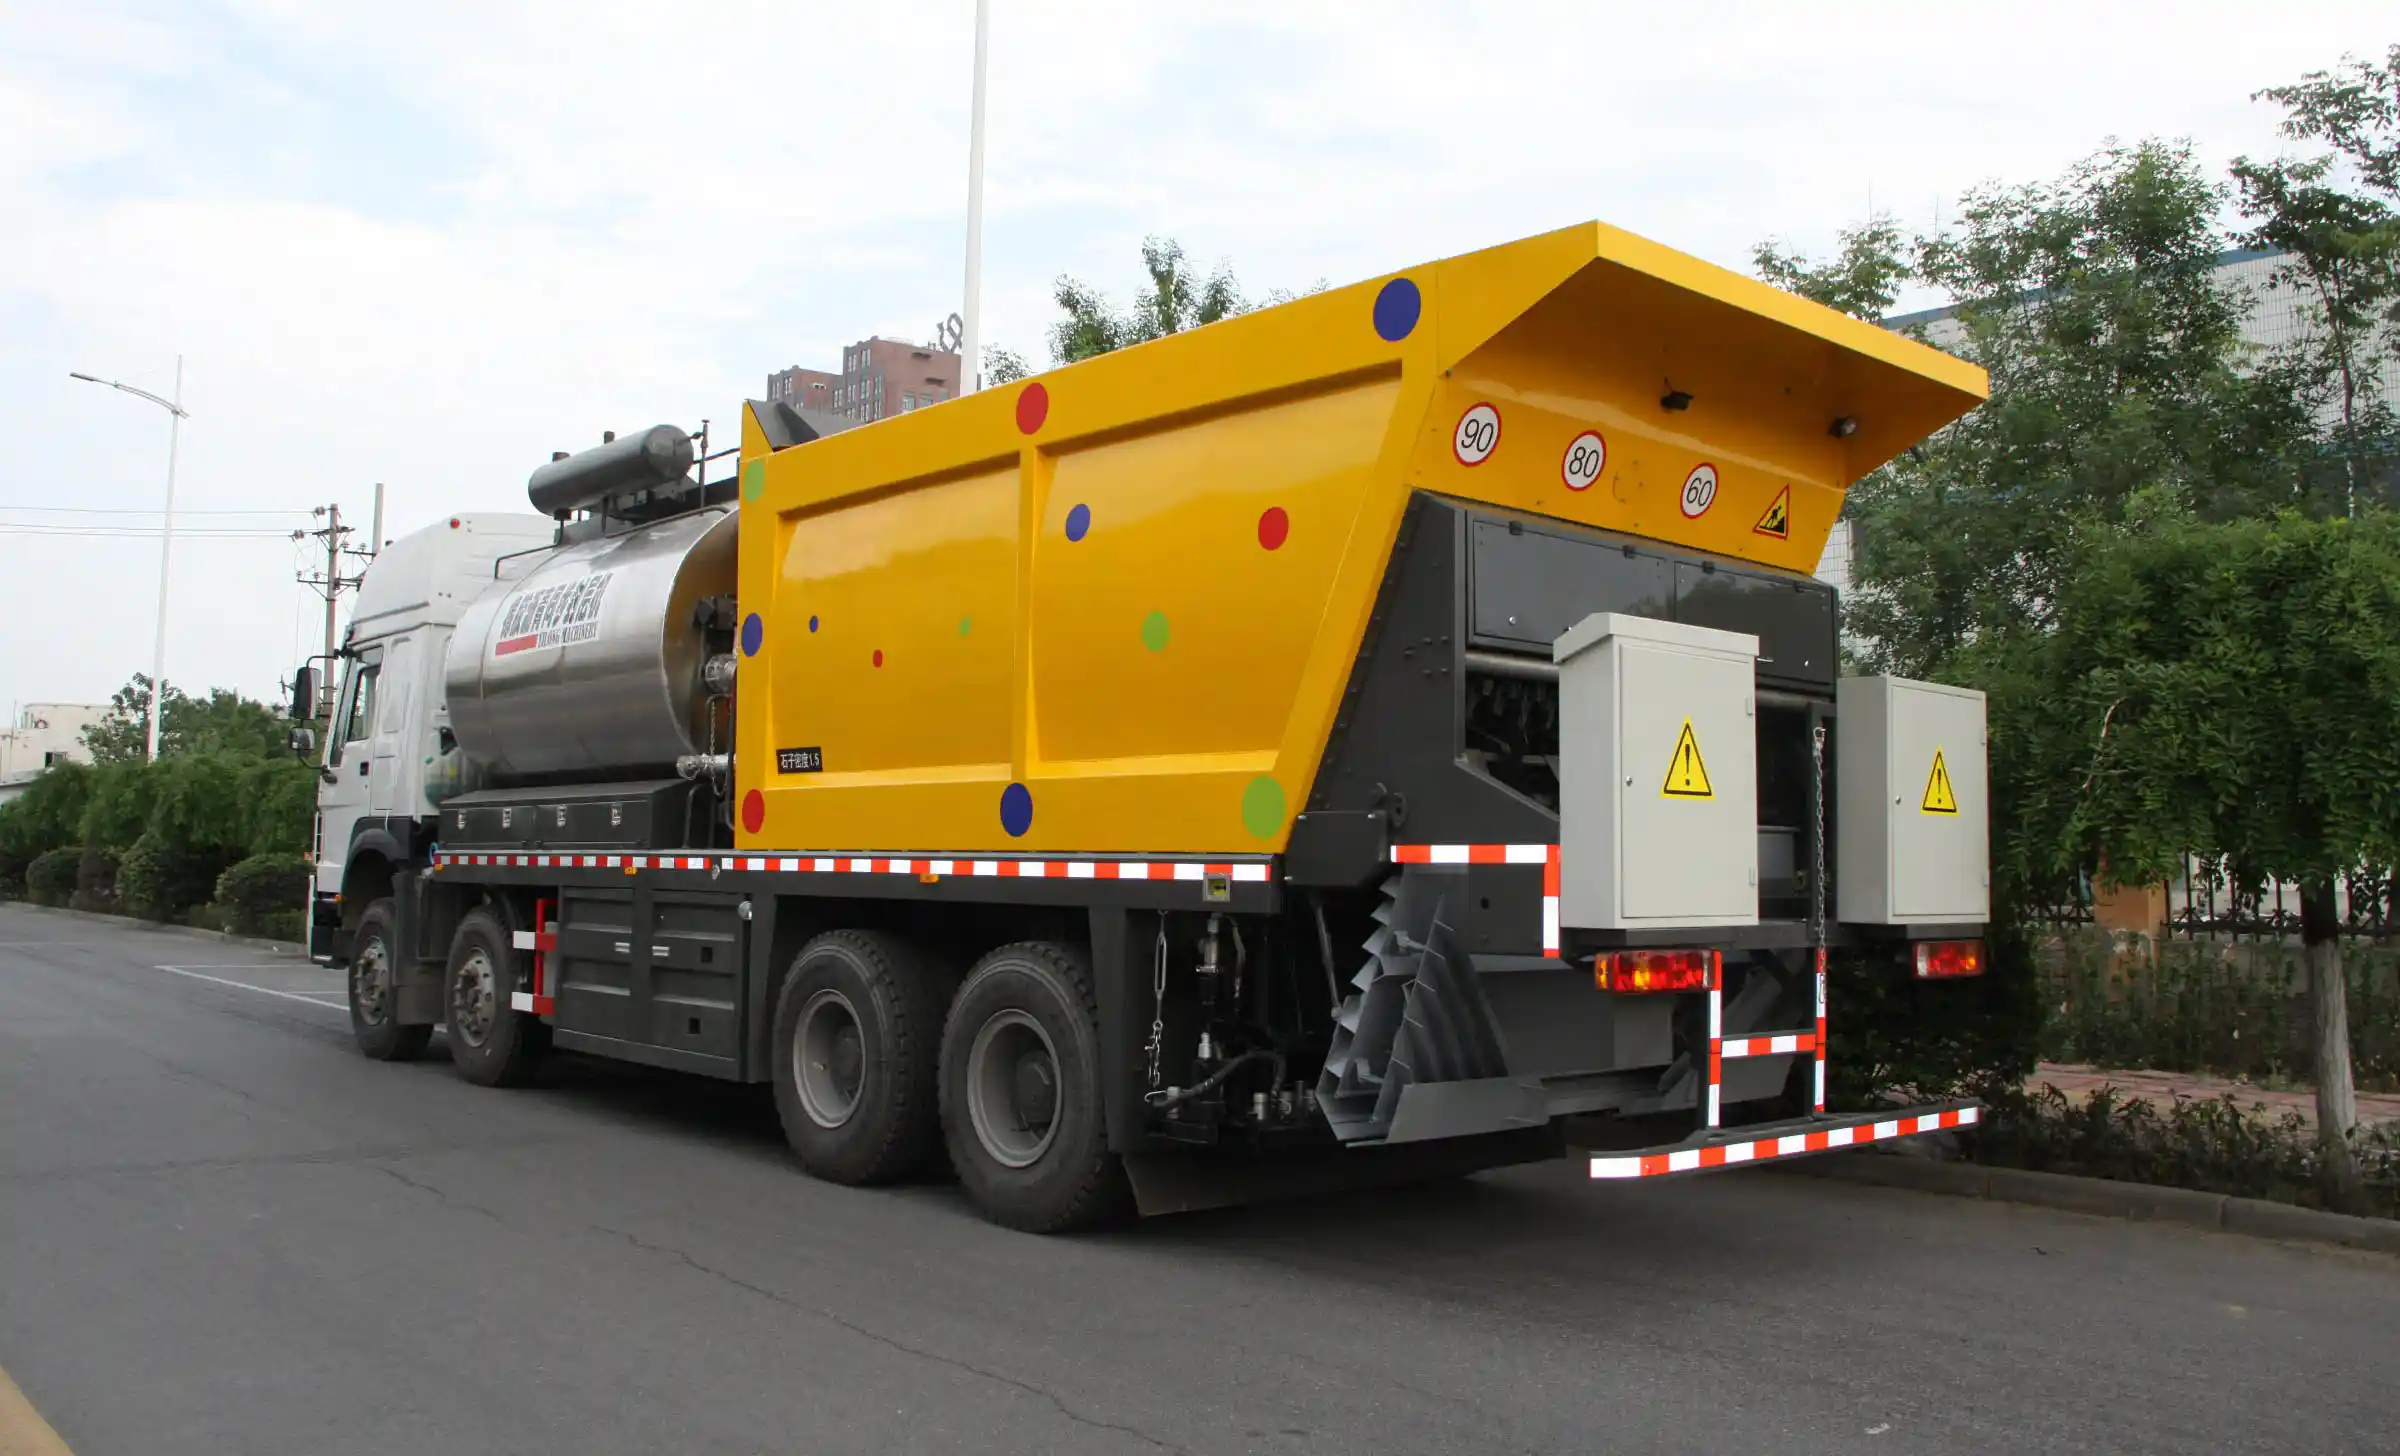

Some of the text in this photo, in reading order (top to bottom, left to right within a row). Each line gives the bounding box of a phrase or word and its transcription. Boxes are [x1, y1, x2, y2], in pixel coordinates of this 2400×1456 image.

[1461, 419, 1494, 452] 90
[1569, 446, 1600, 478] 80
[1686, 477, 1712, 507] 60
